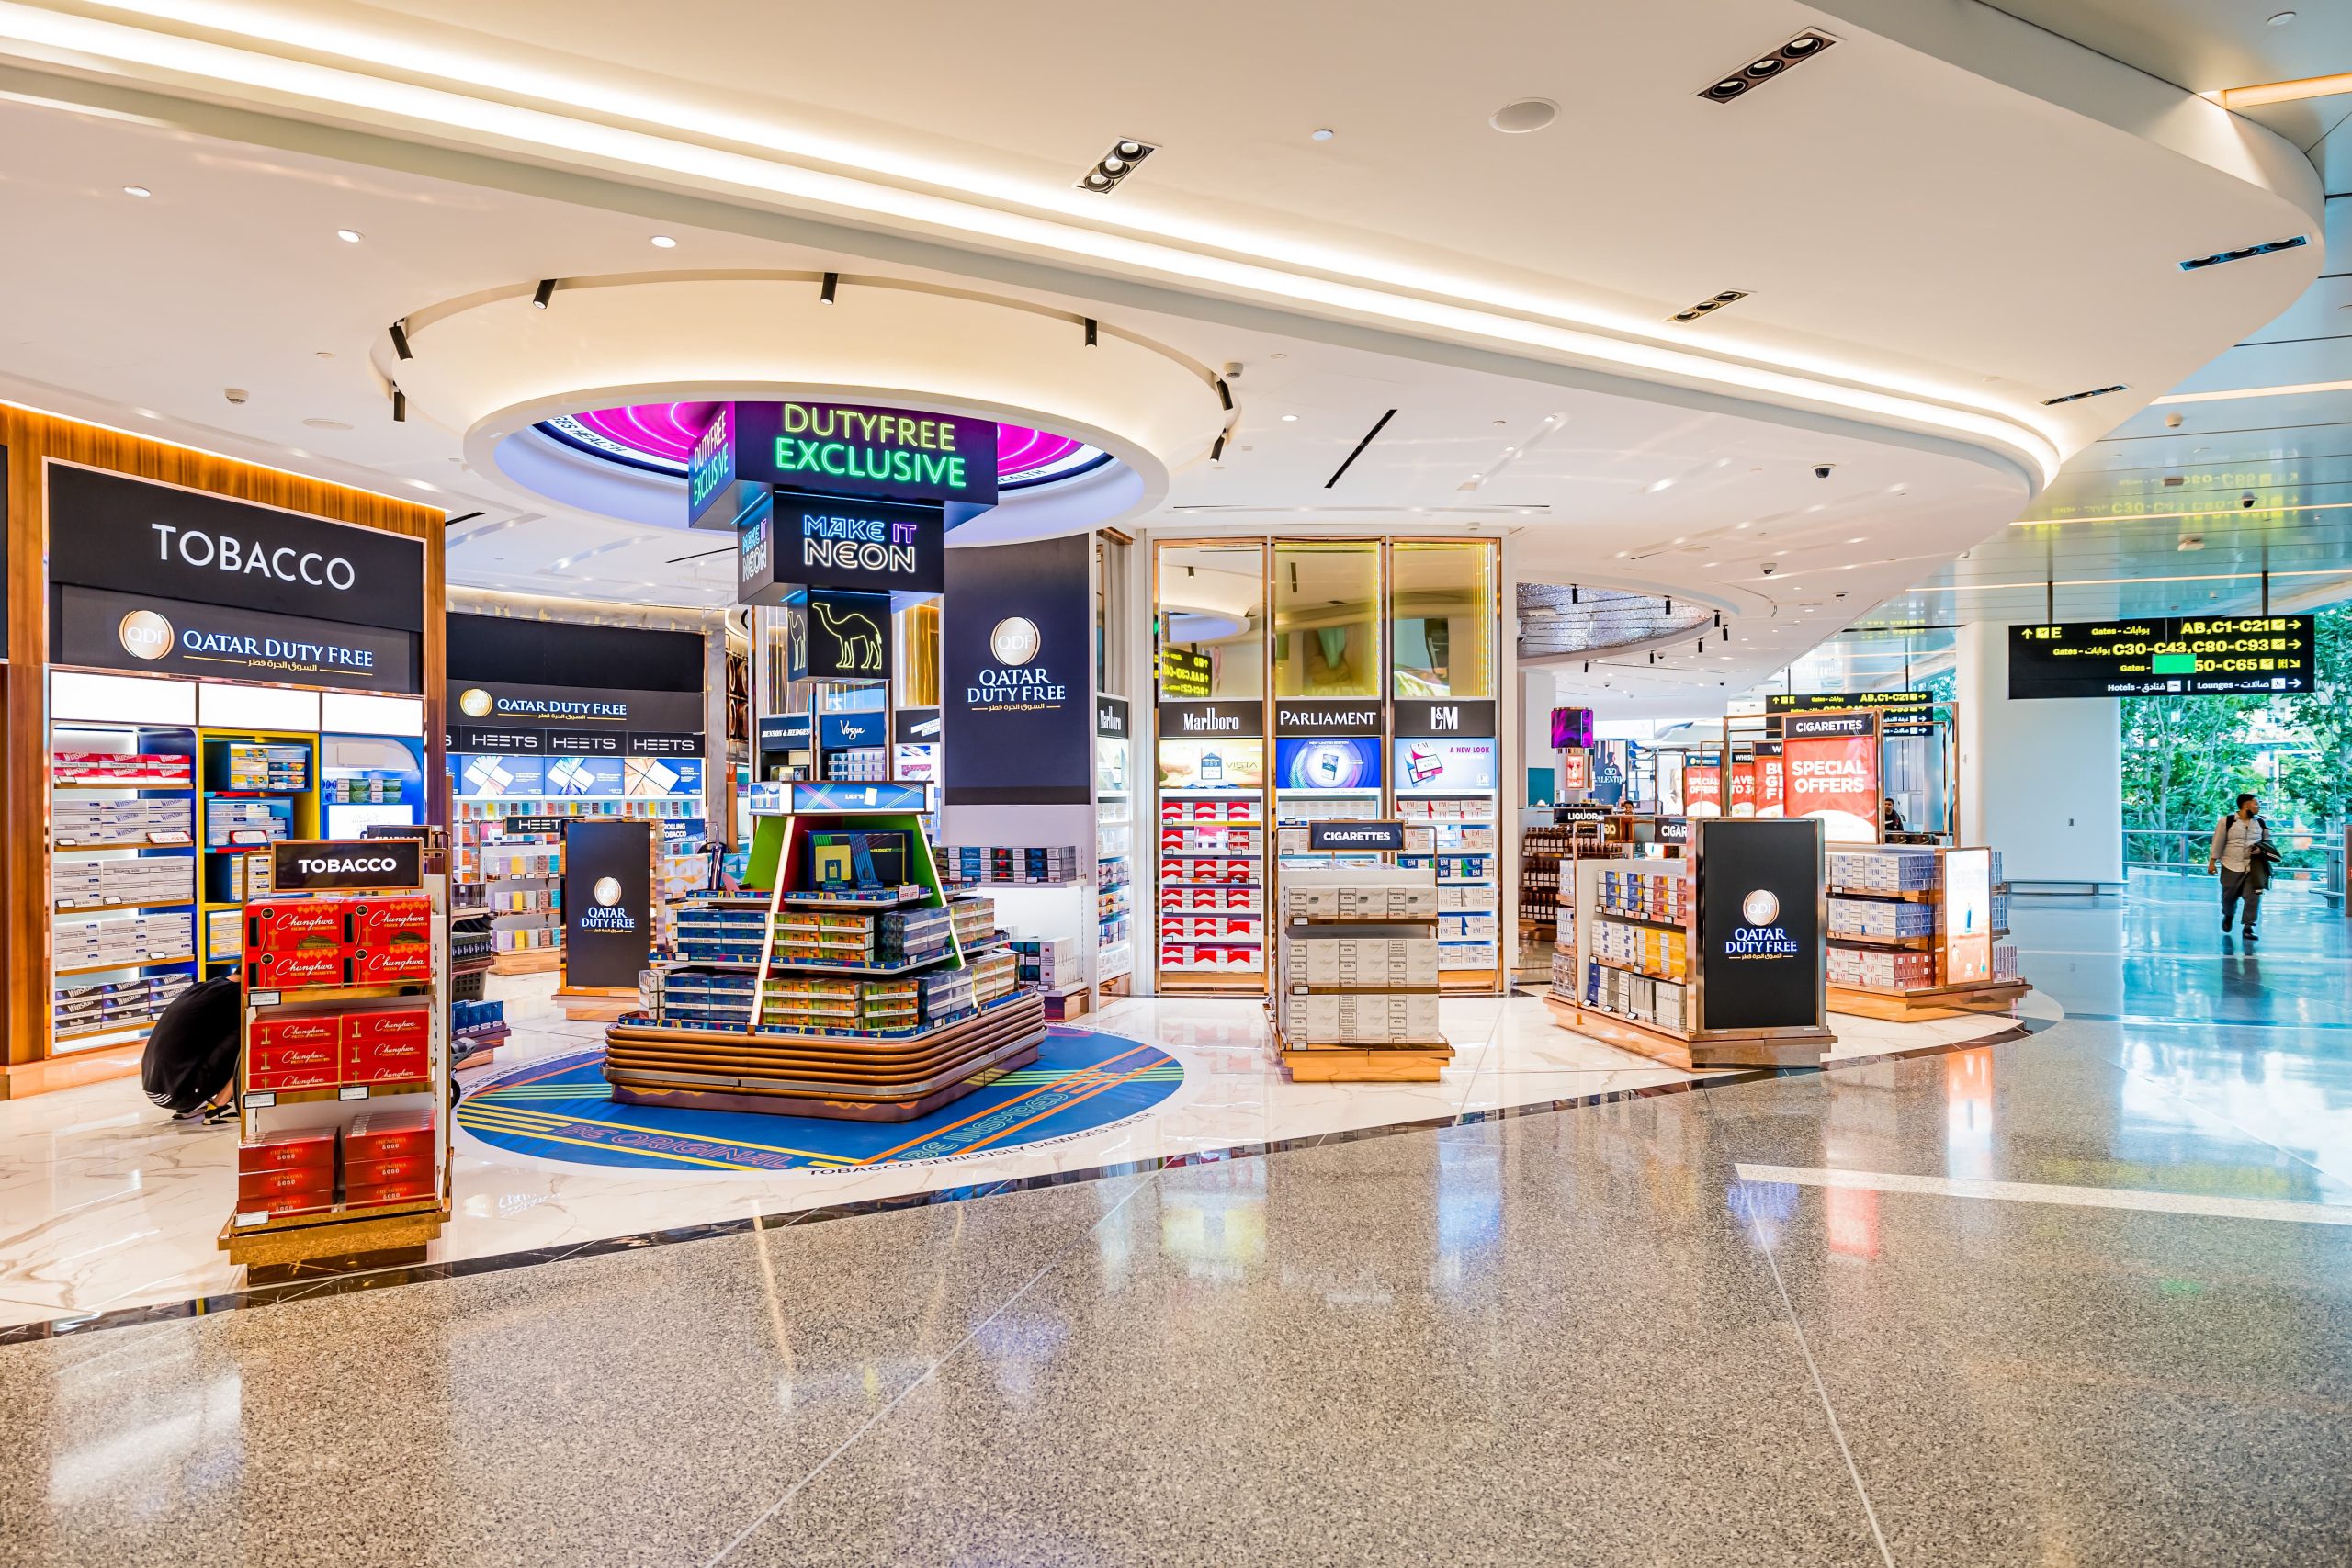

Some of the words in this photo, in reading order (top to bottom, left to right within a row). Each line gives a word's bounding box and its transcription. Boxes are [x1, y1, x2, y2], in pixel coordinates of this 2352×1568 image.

[784, 403, 956, 452] DUTYFREE
[570, 425, 627, 452] HEALTH
[695, 410, 727, 473] DUTYFREE
[775, 436, 967, 488] EXCLUSIVE
[694, 442, 729, 507] EXCLUSIVE
[742, 522, 761, 553] MAKE
[761, 518, 767, 538] IT
[804, 515, 885, 542] MAKE
[892, 523, 917, 545] IT
[152, 523, 356, 591] TOBACCO
[742, 542, 767, 582] NEON
[804, 538, 916, 573] NEON
[2052, 627, 2062, 638] E
[2091, 627, 2117, 636] Gates
[2122, 626, 2150, 635] بوابات
[2180, 619, 2270, 635] AB,C1-C21
[127, 626, 167, 645] QDF
[997, 634, 1034, 649] QDF
[183, 630, 262, 656] QATAR
[265, 639, 324, 662] DUTY
[328, 646, 373, 667] FREE
[2084, 647, 2111, 655] بوابات
[247, 659, 266, 669] قطر
[267, 660, 288, 670] الحرة
[2195, 659, 2258, 671] 50-C65
[978, 668, 1052, 685] QATAR
[2108, 683, 2135, 692] Hotels
[2142, 682, 2165, 692] فنادق
[2197, 682, 2233, 690] Lounges
[967, 686, 1020, 703] DUTY
[1023, 685, 1066, 701] FREE
[497, 698, 548, 712] QATAR
[549, 701, 591, 714] DUTY
[594, 704, 627, 715] FREE
[989, 704, 1003, 712] قطر
[1003, 703, 1021, 711] الحرة
[1021, 703, 1046, 711] السوق
[1183, 707, 1239, 730] Marlboro
[1280, 710, 1376, 726] PARLIAMENT
[1430, 706, 1458, 730] L&M
[840, 720, 865, 740] Vogue
[1796, 720, 1863, 732] CIGARETTES
[472, 734, 537, 748] HEETS
[553, 738, 616, 750] HEETS
[634, 739, 695, 751] HEETS
[1766, 762, 1783, 775] BU
[1791, 759, 1868, 776] SPECIAL
[1732, 775, 1753, 784] AVE
[1765, 775, 1783, 788] GI
[1794, 777, 1865, 794] OFFERS
[518, 819, 561, 830] HEET
[1661, 825, 1688, 838] CIGAR
[1323, 831, 1391, 841] CIGARETTES
[298, 858, 397, 874] TOBACCO
[588, 907, 628, 919] QATAR
[1747, 902, 1774, 914] QDF
[276, 913, 335, 931] Chunghwa
[369, 910, 425, 927] Chunghwa
[582, 918, 610, 928] DUTY
[611, 919, 635, 928] FREE
[1734, 927, 1787, 942] QATAR
[1725, 941, 1764, 953] DUTY
[1765, 940, 1797, 953] FREE
[275, 958, 334, 976] Chunghwa
[368, 953, 425, 970] Chunghwa
[282, 1025, 326, 1039] Chunghwa
[374, 1019, 416, 1032] Chunghwa
[373, 1043, 415, 1056] Chunghwa
[281, 1050, 325, 1064] Chunghwa
[808, 1161, 914, 1176] TOBACCO
[920, 1146, 1026, 1167] SERIOUSLY
[1029, 1128, 1108, 1149] DAMAGES
[1107, 1112, 1156, 1130] HEALTH
